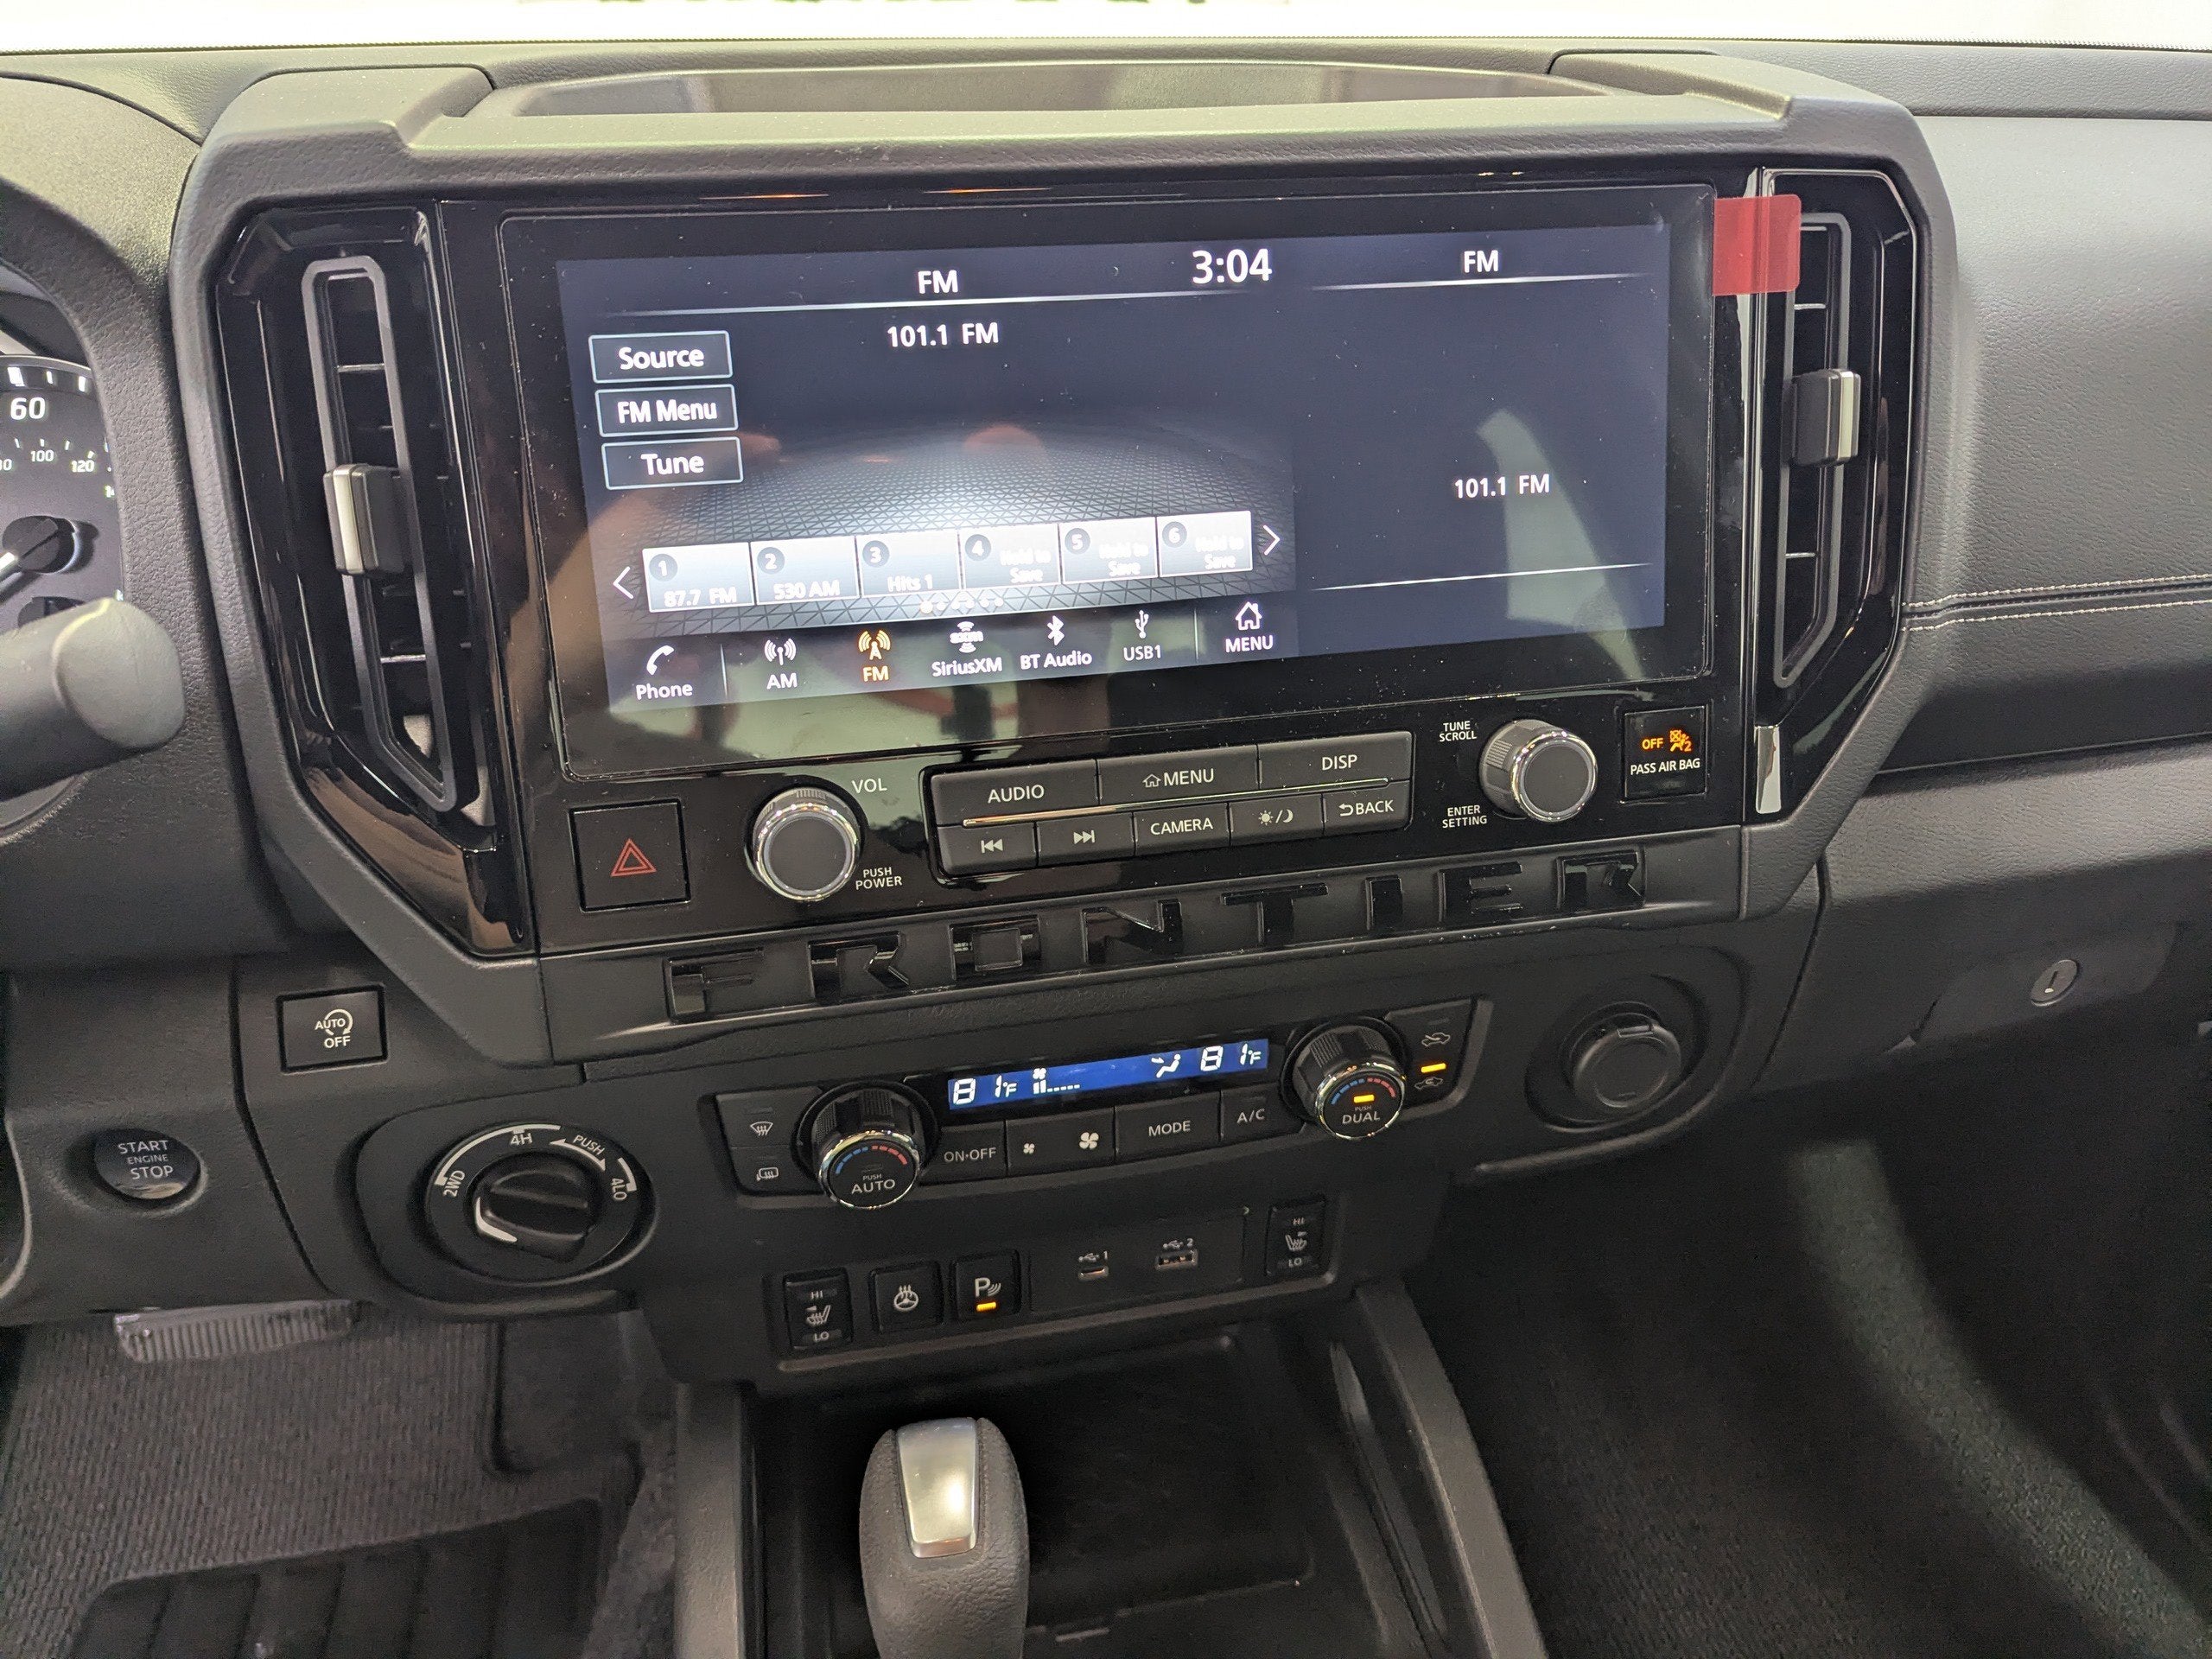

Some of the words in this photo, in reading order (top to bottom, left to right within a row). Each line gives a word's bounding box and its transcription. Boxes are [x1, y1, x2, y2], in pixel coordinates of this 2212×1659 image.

[1192, 247, 1273, 284] 3:04
[1463, 250, 1500, 273] FM
[918, 270, 959, 294] FM
[887, 324, 949, 348] 101.1
[962, 322, 1000, 345] FM
[618, 346, 705, 370] Source
[10, 397, 46, 420] 60
[618, 401, 652, 424] FM
[656, 398, 718, 422] Menu
[30, 449, 54, 462] 100
[72, 460, 94, 473] 120
[640, 453, 705, 475] Tune
[1453, 476, 1507, 499] 101.1
[1518, 474, 1550, 495] FM
[1071, 534, 1084, 550] 5
[1168, 527, 1181, 543] 6
[869, 547, 881, 563] 3
[971, 540, 984, 556] 4
[658, 561, 667, 576] 1
[765, 553, 777, 569] 2
[1108, 561, 1141, 577] Save
[1204, 554, 1236, 569] Save
[887, 575, 921, 592] Hits
[925, 574, 933, 589] 1
[1010, 567, 1044, 584] Save
[664, 589, 701, 607] 87.7
[709, 587, 737, 604] FM
[773, 582, 806, 601] 530
[809, 579, 841, 598] AM
[1225, 635, 1274, 653] MENU
[1020, 653, 1041, 671] BT
[1043, 650, 1092, 669] Audio
[1123, 645, 1161, 661] USB1
[862, 666, 889, 683] FM
[931, 658, 1002, 677] SiriusXM
[766, 672, 798, 690] AM
[636, 683, 693, 701] Phone
[1443, 721, 1471, 731] TUNE
[1439, 730, 1477, 742] SCROLL
[1641, 737, 1664, 750] OFF
[1321, 754, 1358, 770] DISP
[1630, 763, 1657, 775] PASS
[1658, 760, 1676, 773] AIR
[1679, 758, 1700, 771] BAG
[1163, 768, 1215, 787] MENU
[851, 778, 887, 795] VOL
[987, 785, 1046, 804] AUDIO
[1355, 799, 1395, 816] BACK
[1446, 805, 1481, 817] ENTER
[1149, 817, 1214, 836] CAMERA
[1442, 816, 1487, 829] SETTING
[862, 867, 893, 879] PUSH
[855, 875, 903, 891] POWER
[664, 849, 1644, 1020] FRONTIER
[315, 1019, 346, 1030] AUTO
[324, 1036, 350, 1048] OFF
[1236, 1108, 1265, 1123] A/C
[1343, 1111, 1381, 1124] DUAL
[1148, 1120, 1191, 1136] MODE
[118, 1140, 168, 1154] START
[510, 1133, 532, 1146] 4H
[573, 1135, 605, 1156] PUSH
[127, 1154, 168, 1165] ENGINE
[130, 1165, 173, 1179] STOP
[863, 1173, 882, 1181] PUSH
[443, 1170, 466, 1197] 2WD
[611, 1177, 627, 1201] 4LO
[851, 1179, 896, 1195] AUTO
[1186, 1237, 1193, 1247] 2
[1288, 1257, 1302, 1268] LO
[810, 1290, 823, 1300] HI
[813, 1331, 830, 1343] LO
